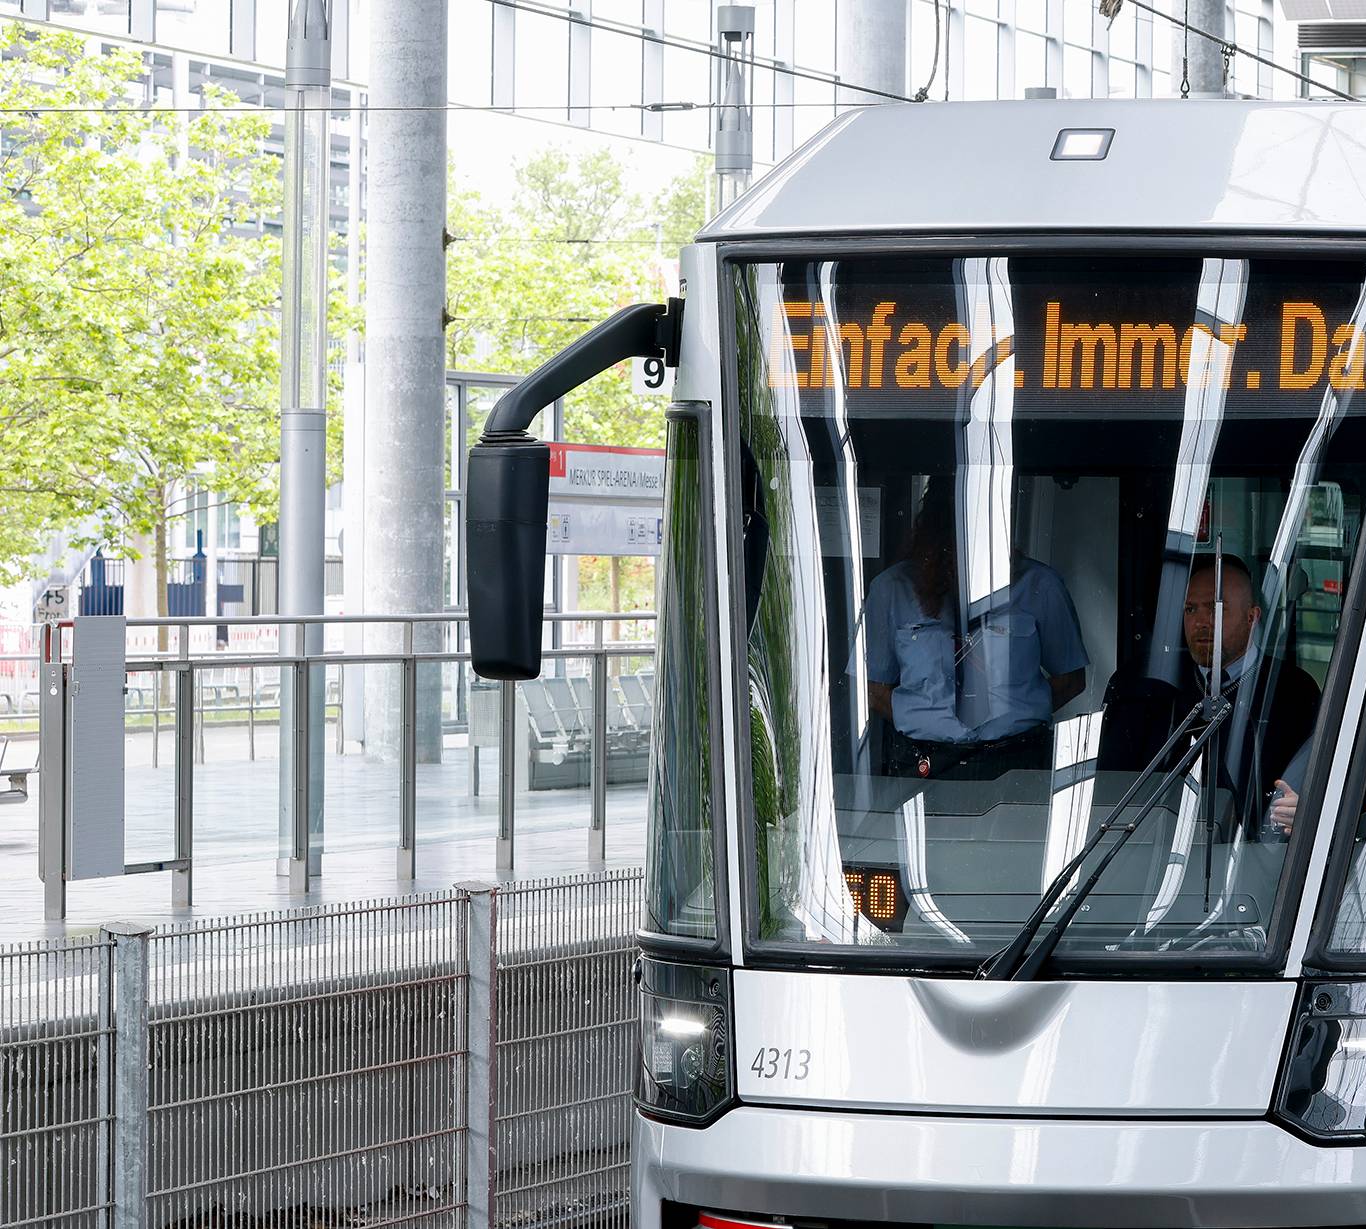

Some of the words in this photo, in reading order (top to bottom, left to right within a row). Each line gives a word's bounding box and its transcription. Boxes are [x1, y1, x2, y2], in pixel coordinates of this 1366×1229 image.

[1043, 302, 1260, 389] Immer.
[643, 357, 665, 389] 9
[750, 1047, 812, 1080] 4313
